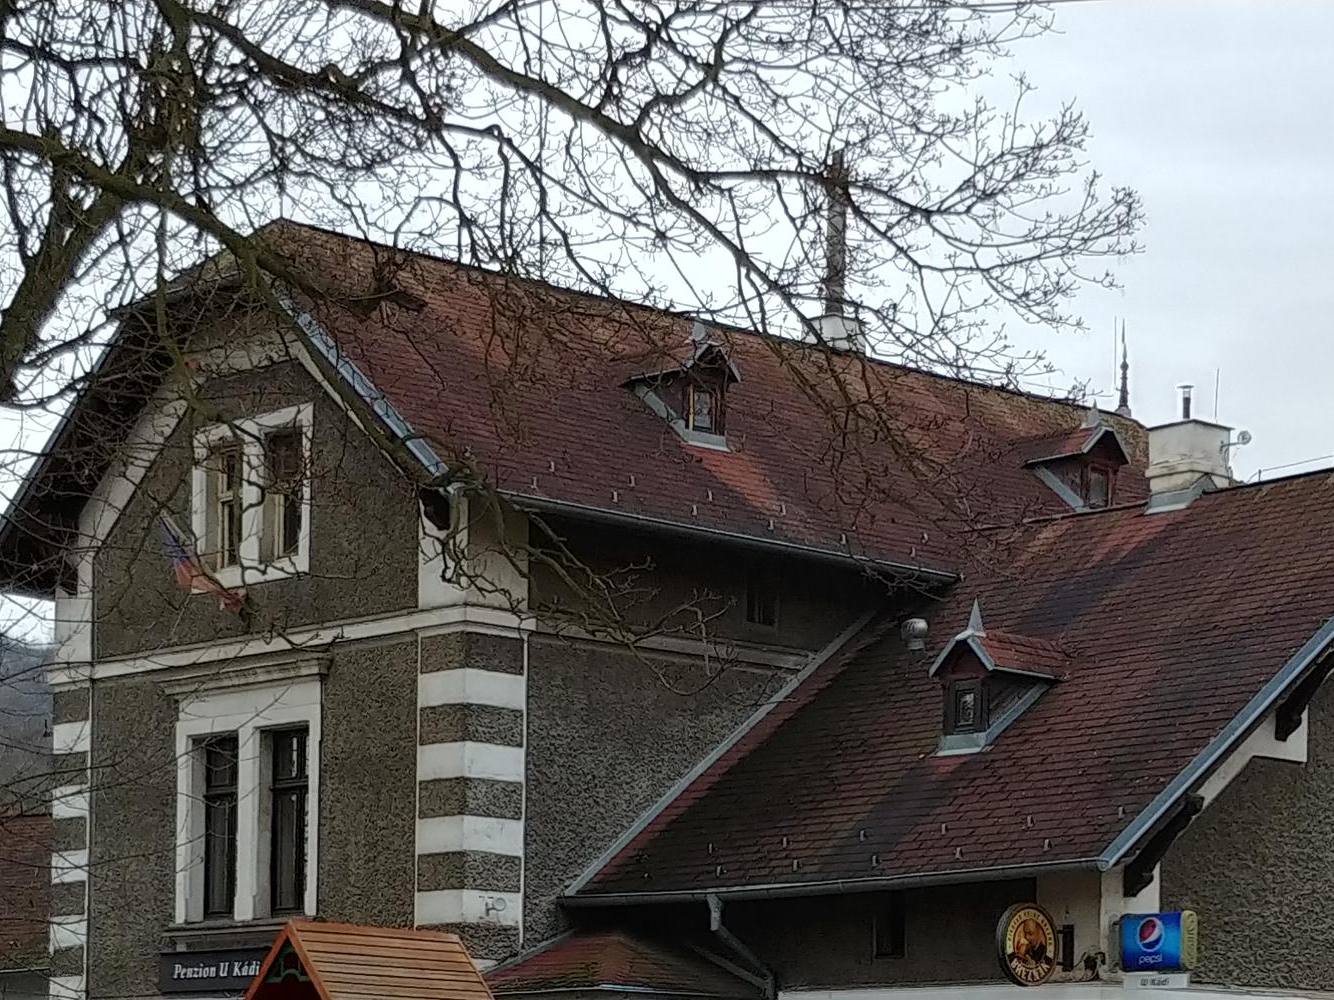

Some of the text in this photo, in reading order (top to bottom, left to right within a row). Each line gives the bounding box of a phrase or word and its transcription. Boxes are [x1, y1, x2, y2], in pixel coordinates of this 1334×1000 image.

[1138, 953, 1163, 967] pepsi
[173, 960, 261, 979] Penzion U Kádi
